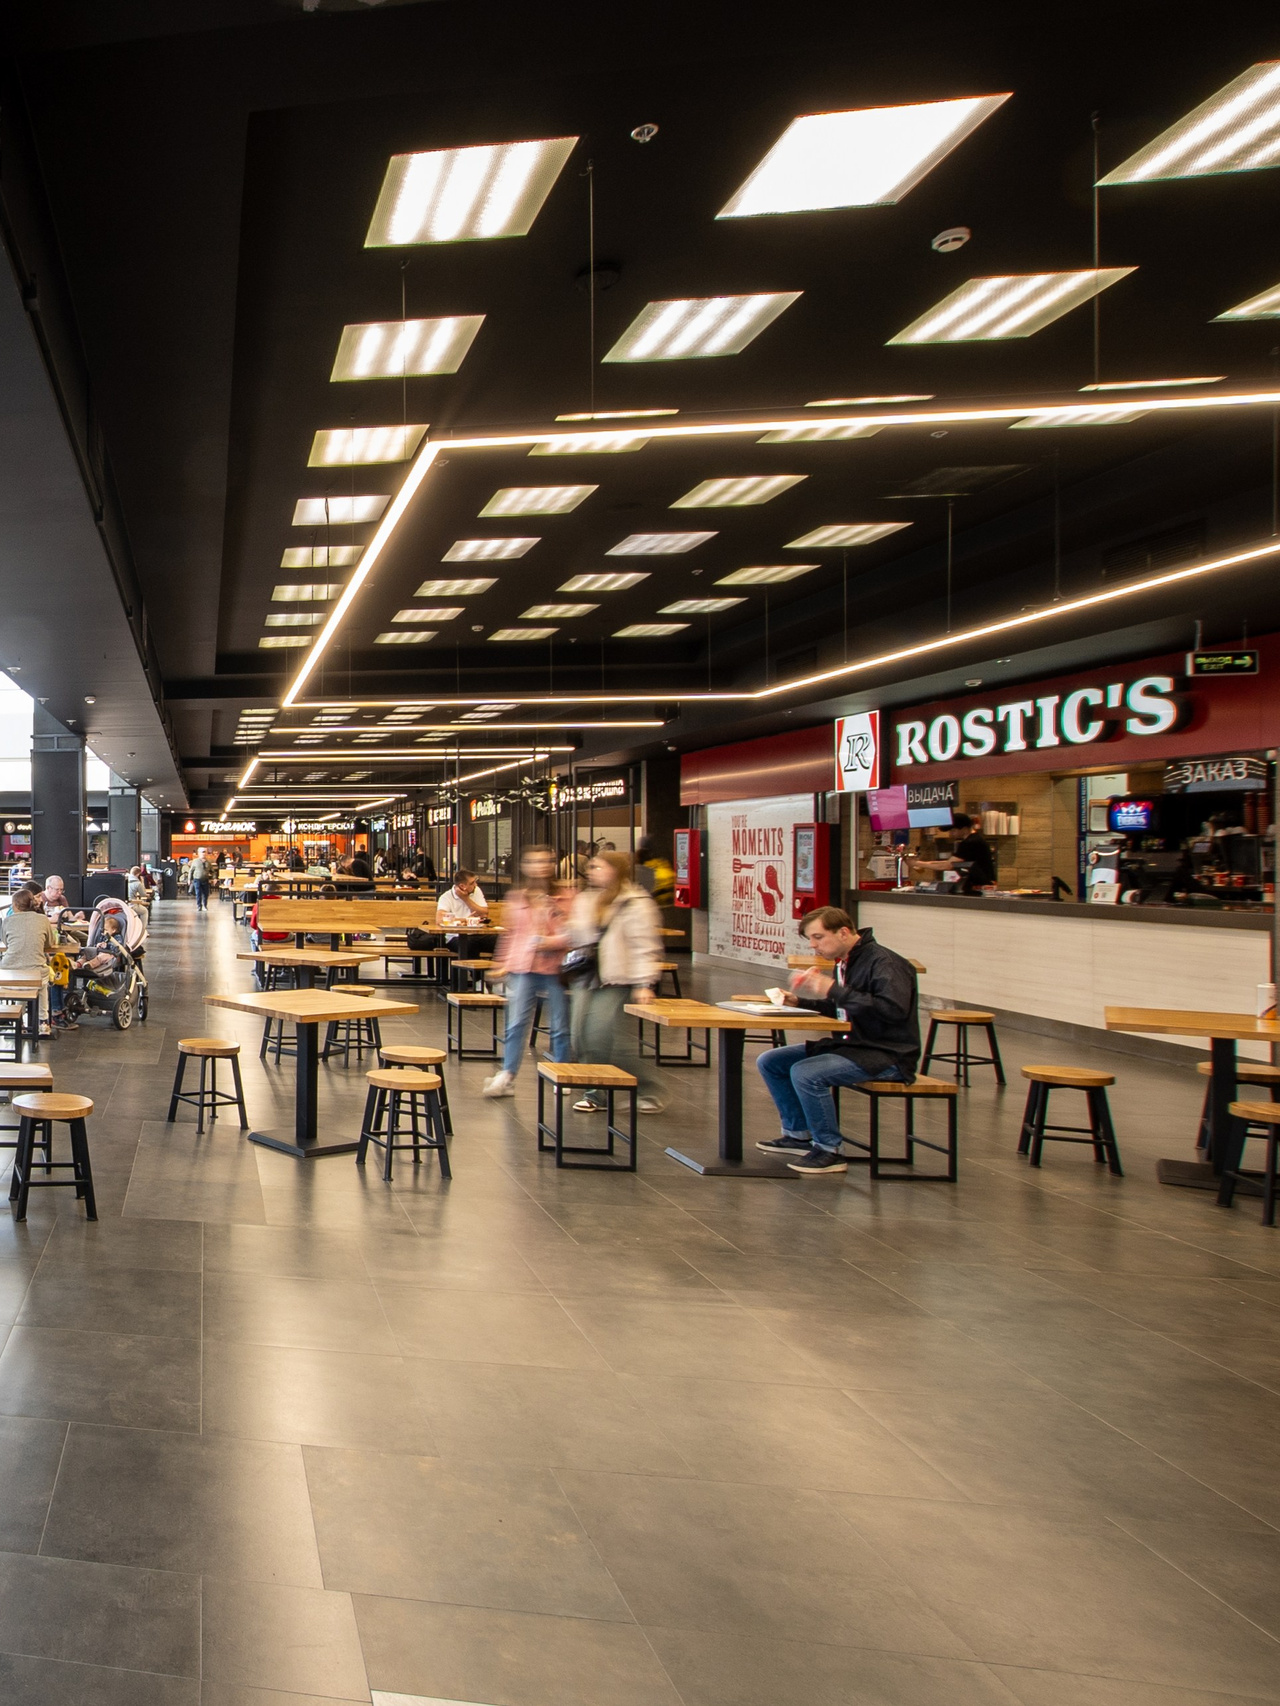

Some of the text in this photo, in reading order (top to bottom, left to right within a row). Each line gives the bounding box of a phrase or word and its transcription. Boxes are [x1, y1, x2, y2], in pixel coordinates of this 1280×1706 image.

[895, 676, 1177, 767] ROSTIC'S
[1181, 760, 1249, 784] ЗАКАЗ
[908, 784, 955, 804] ВЫДАЧА
[200, 821, 257, 834] Теремок
[732, 827, 784, 856] MOMENTS
[732, 875, 754, 900] AWAY
[732, 899, 753, 913] FROM THE
[732, 913, 753, 934] TASTE
[732, 934, 786, 955] PERFECTION
